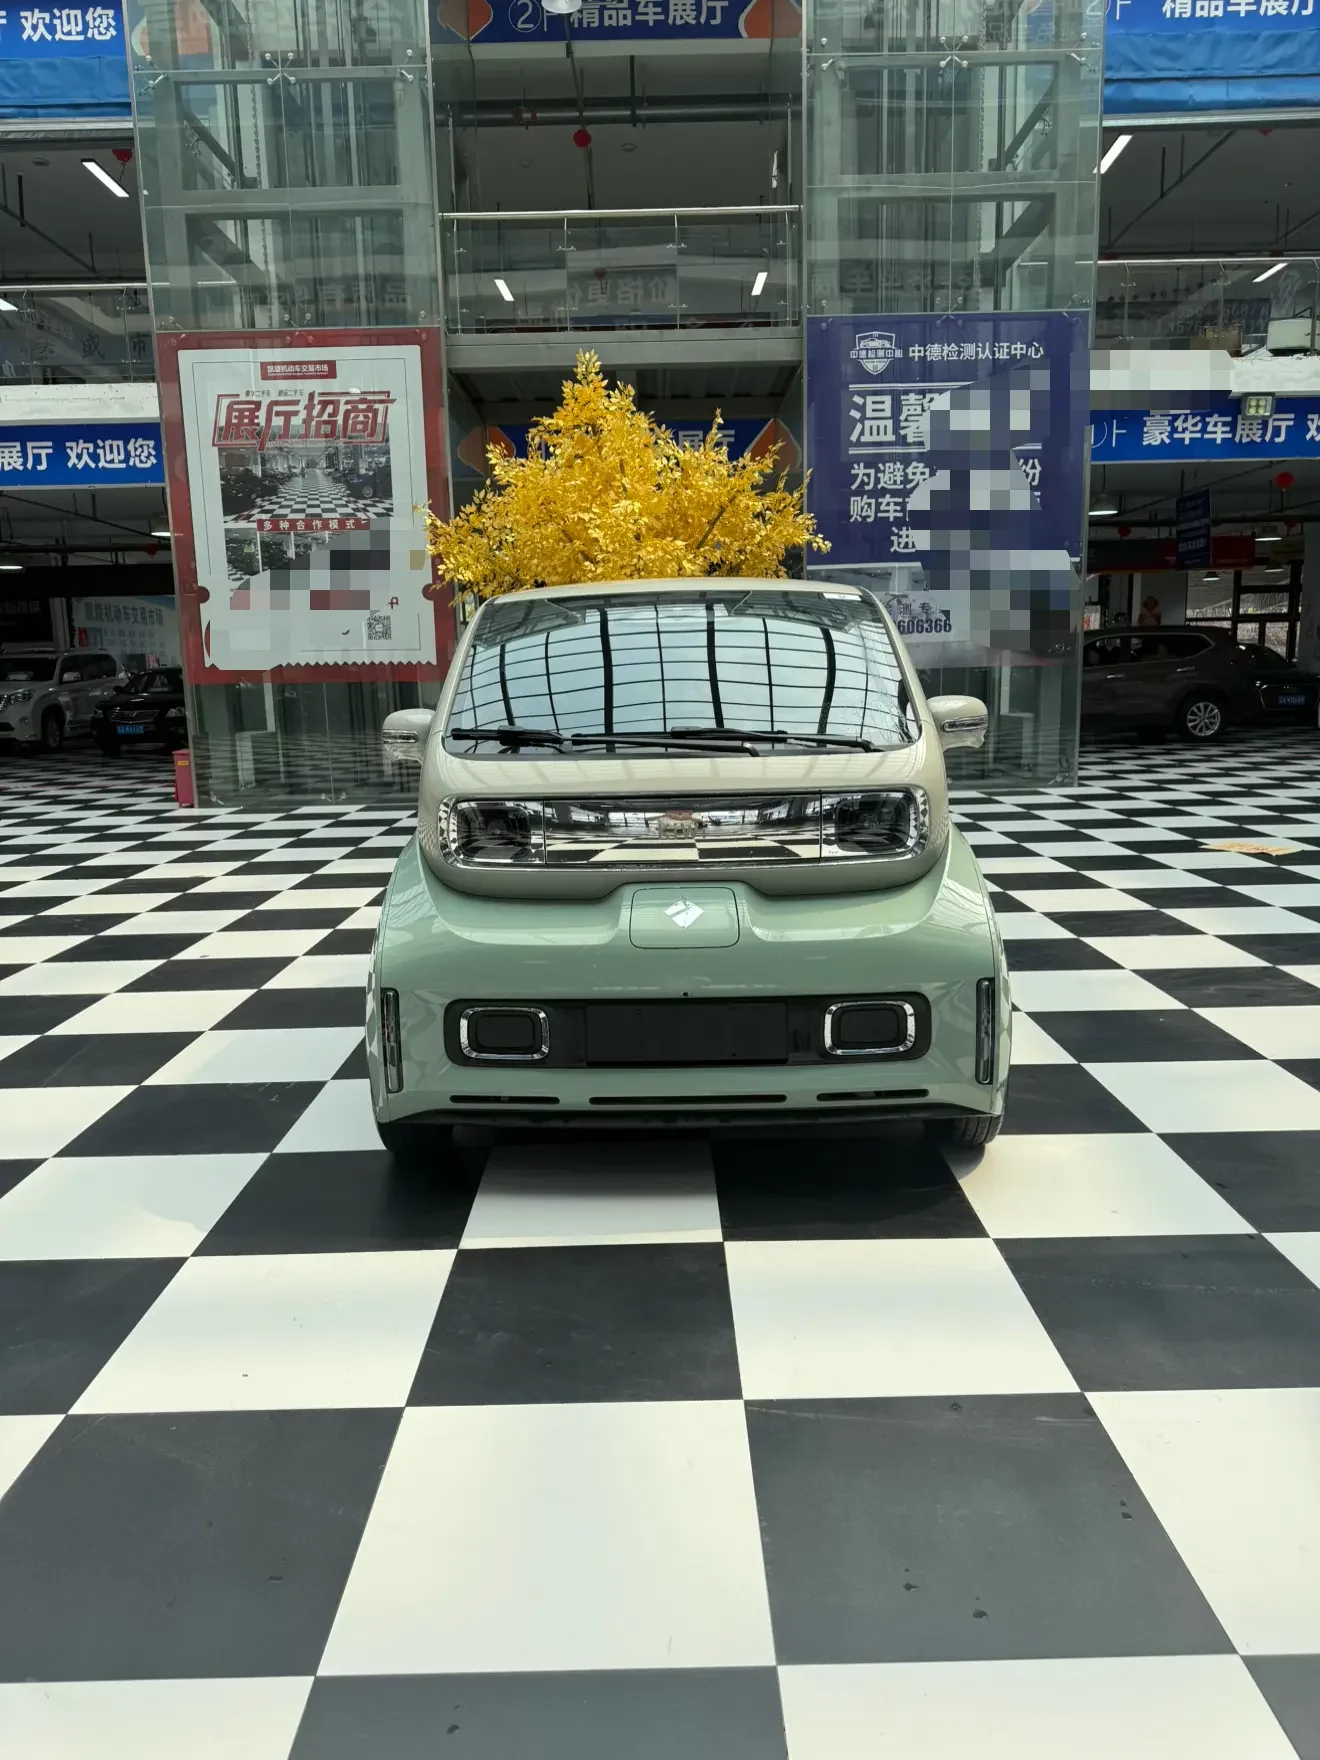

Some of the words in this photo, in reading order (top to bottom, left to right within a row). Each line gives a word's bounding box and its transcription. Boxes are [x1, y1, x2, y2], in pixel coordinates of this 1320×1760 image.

[20, 7, 117, 42] 欢迎您
[909, 342, 1044, 361] 中德检测认证中心
[221, 391, 397, 451] 展厅招商
[1142, 413, 1295, 446] 豪华车展厅
[65, 437, 157, 470] 欢迎您
[263, 518, 357, 531] 多种合作模式
[850, 494, 912, 522] 购车
